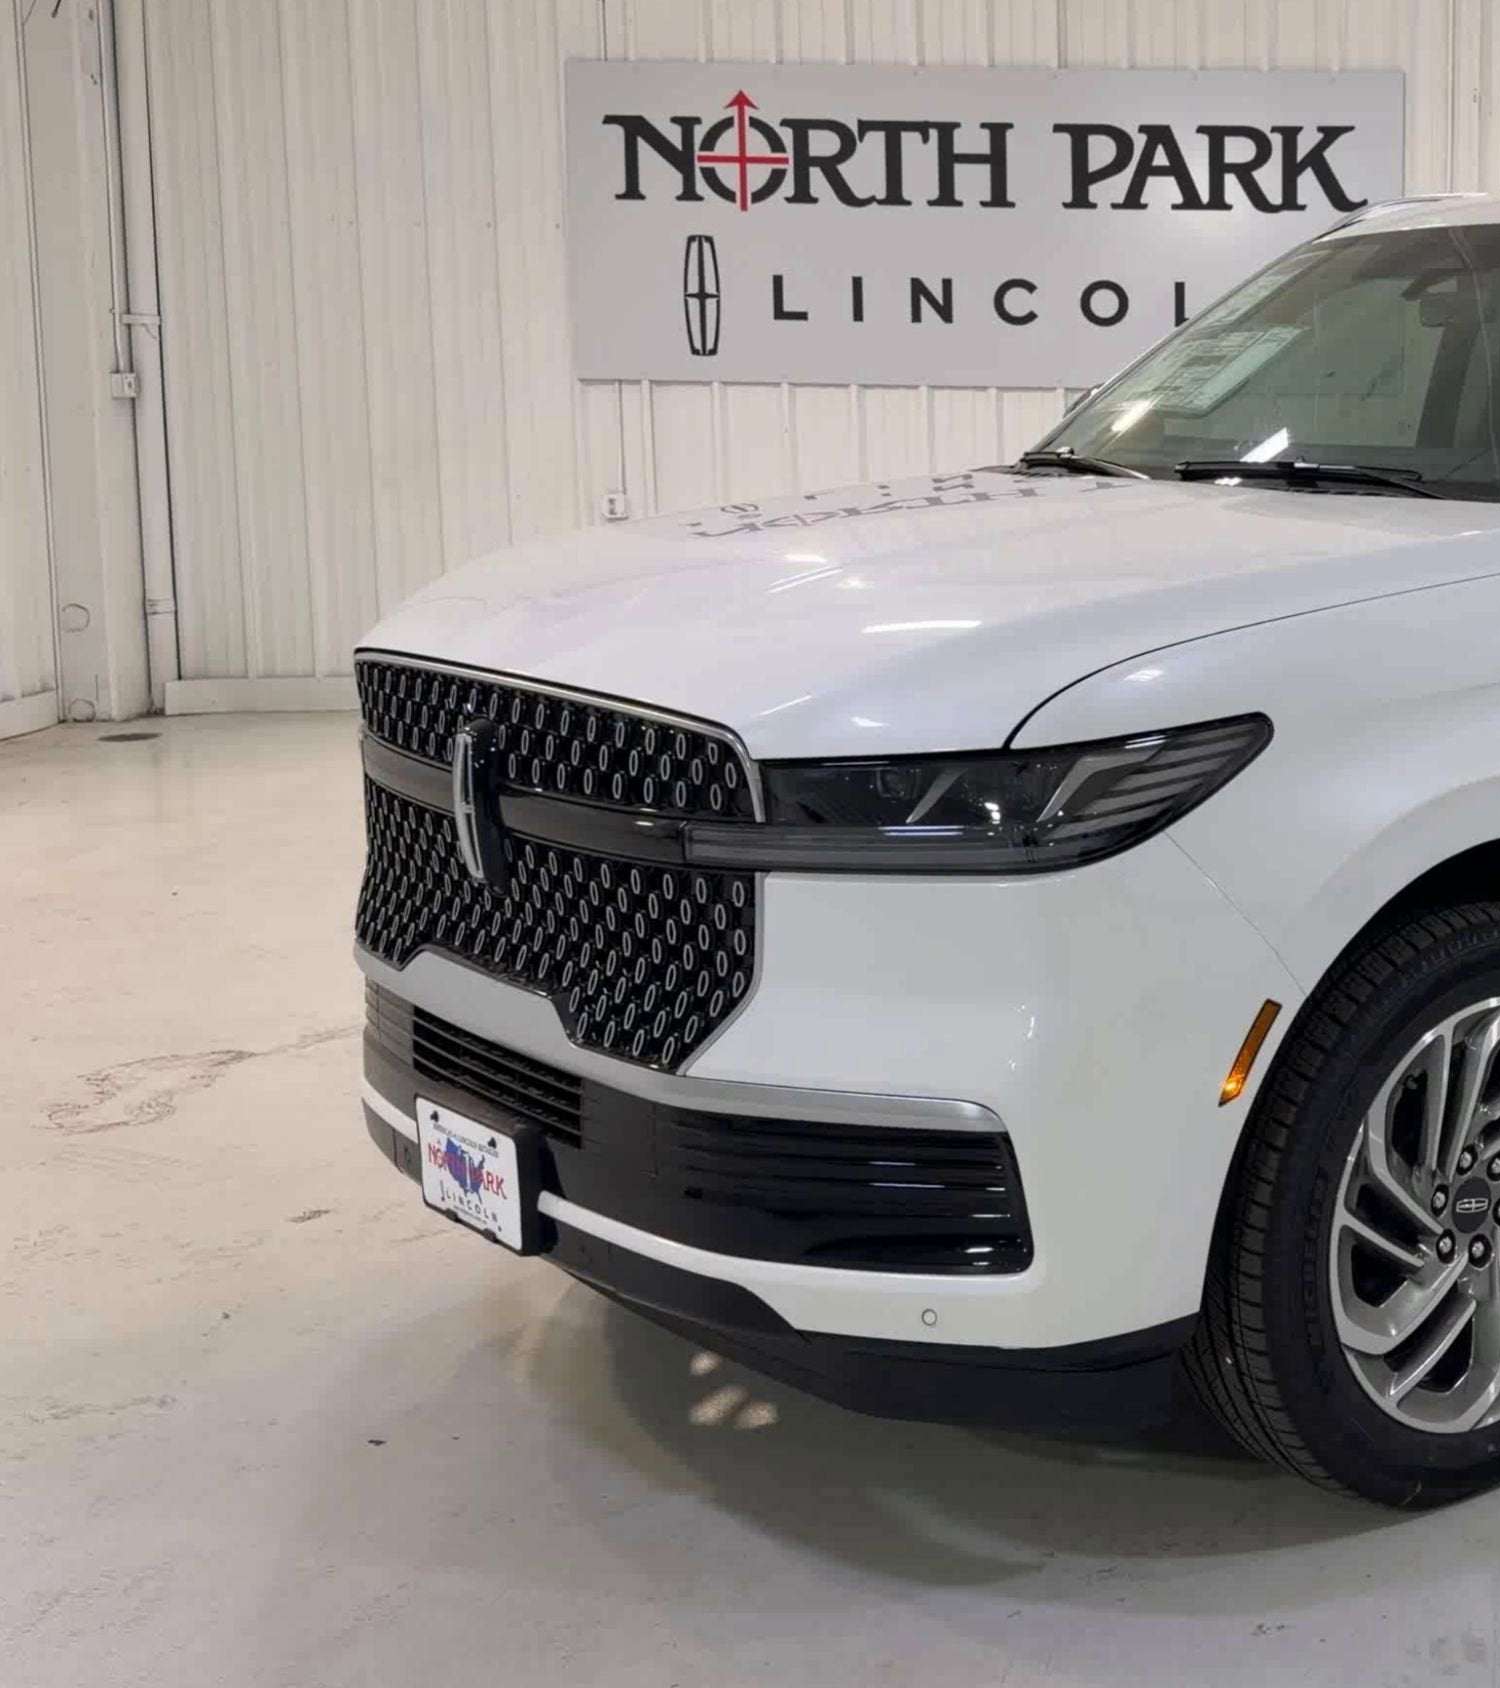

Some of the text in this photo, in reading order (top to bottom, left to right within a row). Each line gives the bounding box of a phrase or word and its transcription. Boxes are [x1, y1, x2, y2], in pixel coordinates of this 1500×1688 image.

[602, 112, 1369, 214] NORTH PARK
[772, 274, 1189, 328] LINCOL
[446, 1188, 498, 1222] LINCOLN
